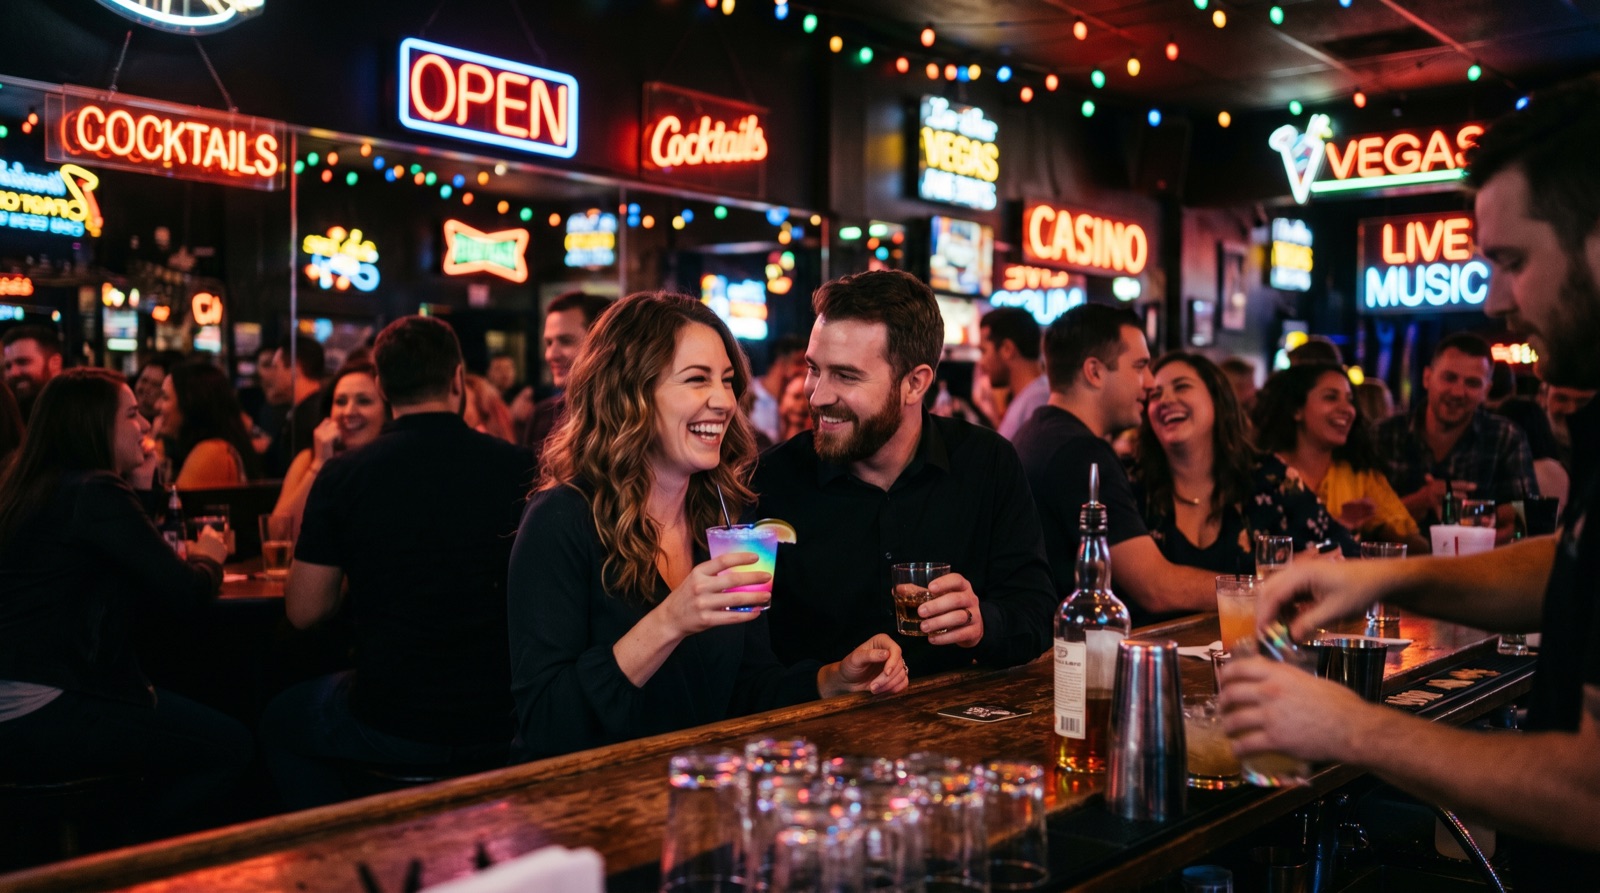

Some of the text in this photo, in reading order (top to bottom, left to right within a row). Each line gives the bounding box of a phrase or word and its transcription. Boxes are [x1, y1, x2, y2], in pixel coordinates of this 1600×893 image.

[411, 54, 567, 146] OPEN
[77, 105, 278, 177] COCKTAILS
[650, 114, 768, 168] Cocktails
[921, 126, 999, 182] VEGAS
[1029, 204, 1148, 275] CASINO
[1382, 217, 1470, 264] LIVE
[1365, 260, 1490, 308] MUSIC
